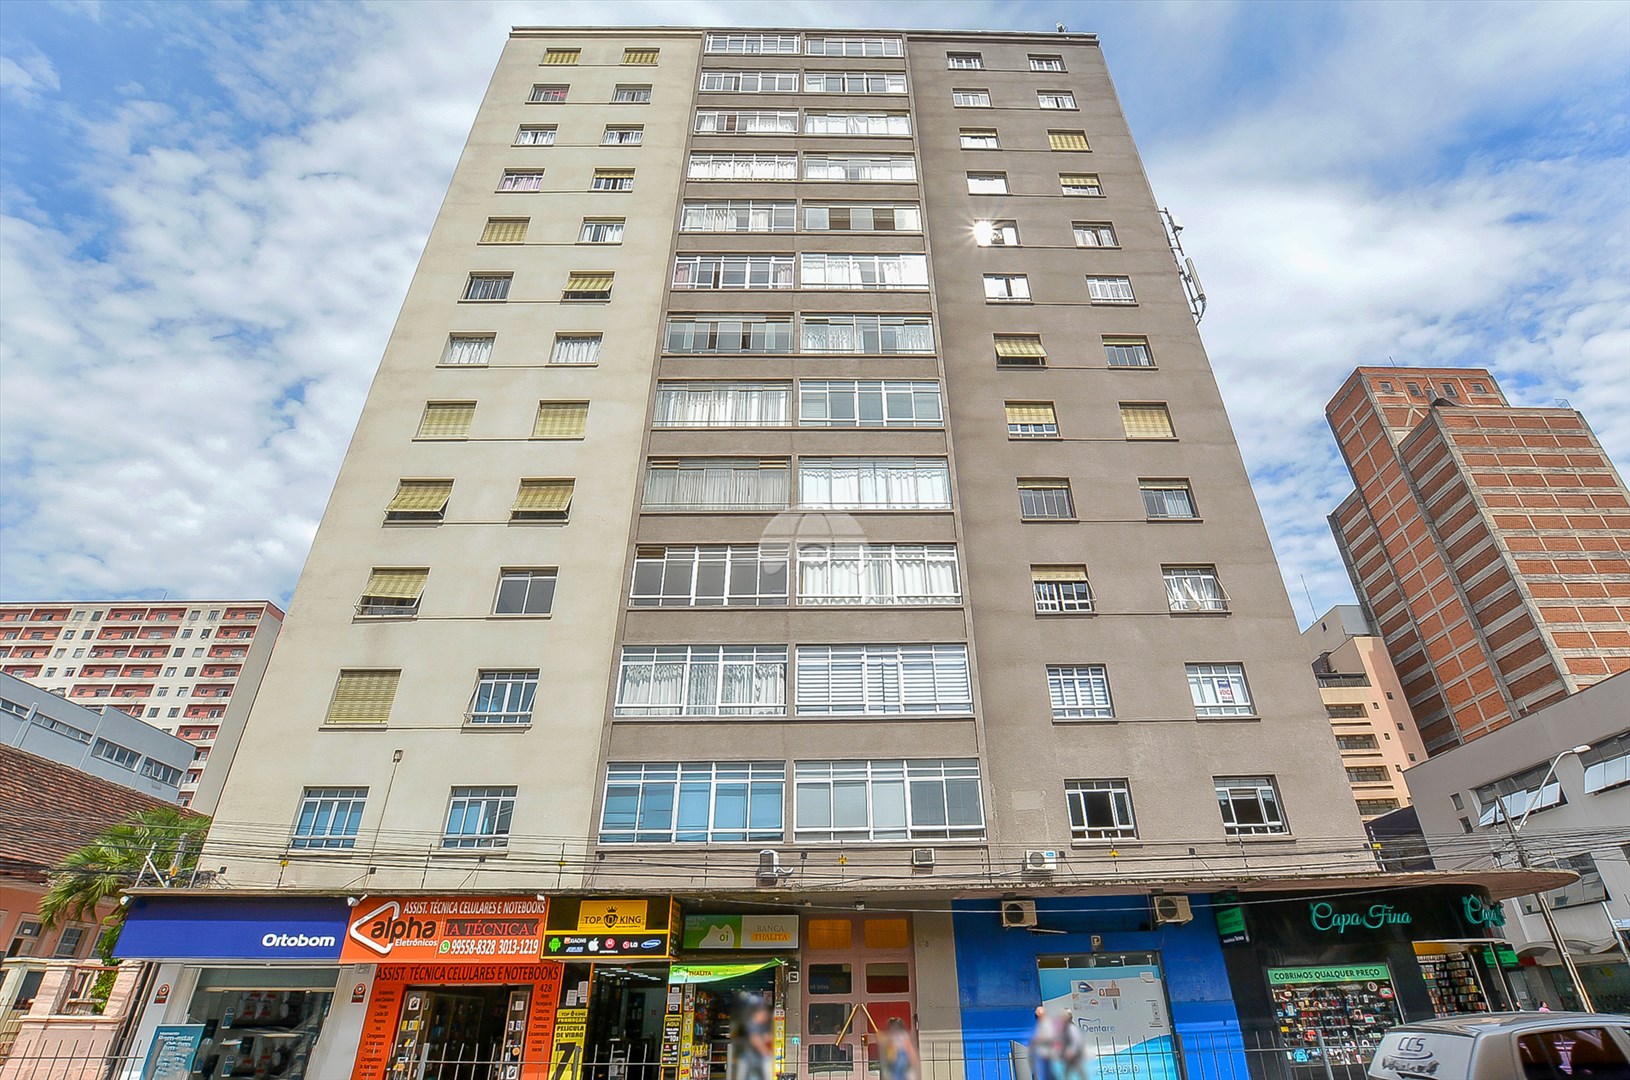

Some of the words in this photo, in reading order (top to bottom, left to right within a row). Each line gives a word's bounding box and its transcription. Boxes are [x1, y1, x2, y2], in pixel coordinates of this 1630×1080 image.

[403, 901, 428, 914] ASSIST.
[429, 898, 458, 914] TÉCNICA
[459, 901, 497, 914] CELULARES
[497, 902, 502, 914] E
[503, 900, 546, 914] NOTEBOOKS
[584, 915, 602, 925] TOP
[619, 915, 642, 924] KING
[1309, 902, 1361, 934] Capa
[1362, 904, 1412, 929] Fina
[370, 916, 437, 943] alpha
[464, 919, 529, 936] TÉCNICA
[756, 924, 785, 932] BANCA
[262, 933, 335, 947] Ortobom
[394, 938, 438, 947] Eletrônicos
[752, 932, 789, 941] THALITA
[450, 939, 496, 954] 99558-8328
[497, 938, 539, 955] 3013-1219
[375, 966, 406, 980] ASSIST.
[409, 963, 446, 980] TÉCNICA
[447, 966, 496, 981] CELULARES
[497, 966, 503, 980] E
[504, 965, 559, 981] NOTEBOOKS
[1274, 971, 1313, 980] COBRIMOS
[1315, 969, 1354, 978] QUALQUER
[1356, 968, 1380, 978] PREÇO
[540, 984, 552, 993] 428
[1082, 1024, 1116, 1033] Dentare
[1397, 1036, 1426, 1053] CCS
